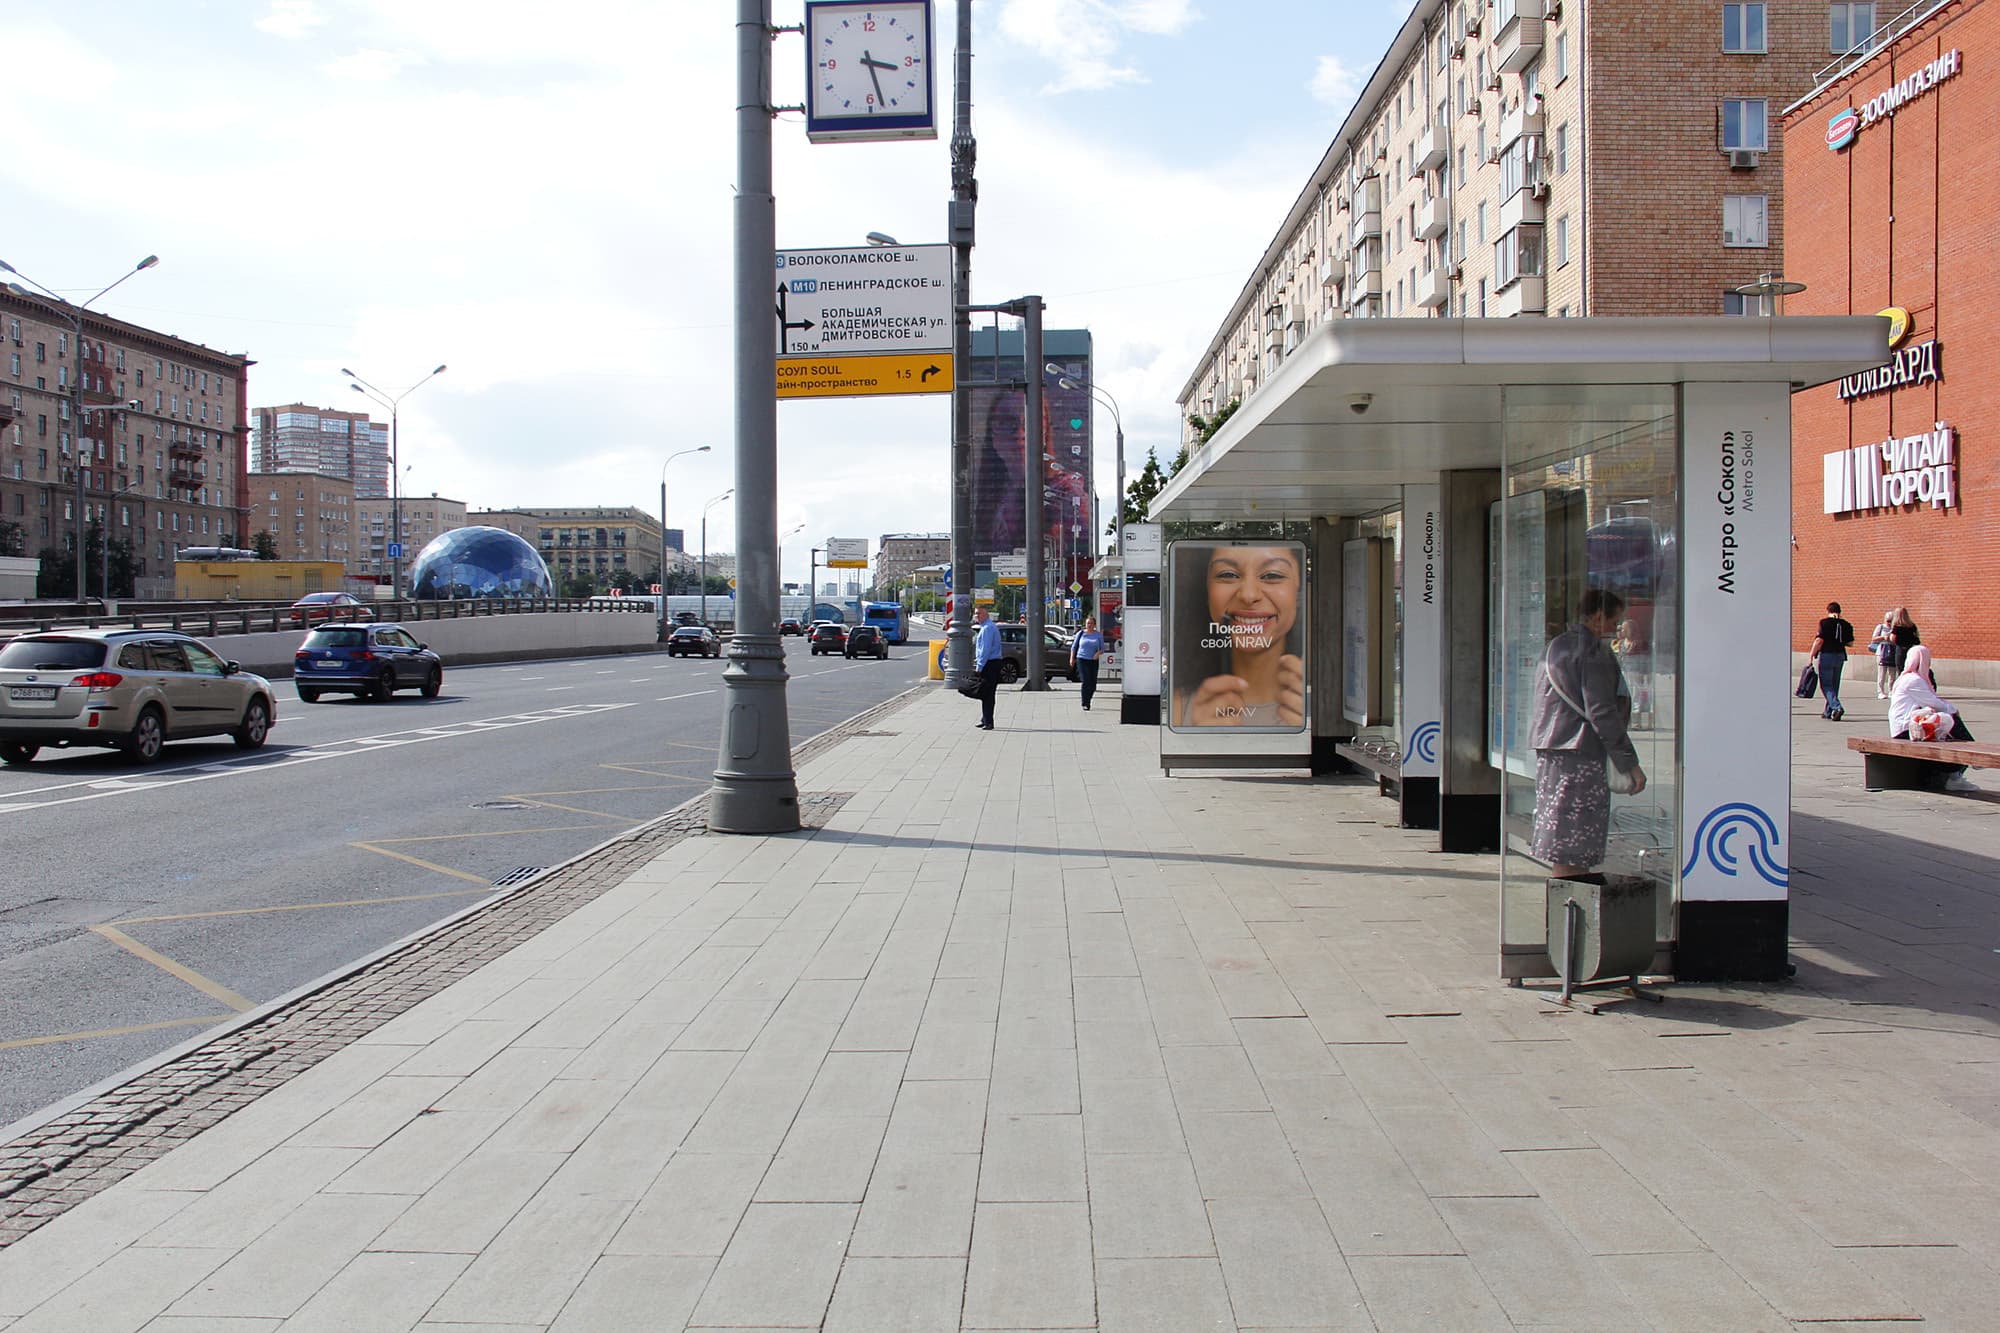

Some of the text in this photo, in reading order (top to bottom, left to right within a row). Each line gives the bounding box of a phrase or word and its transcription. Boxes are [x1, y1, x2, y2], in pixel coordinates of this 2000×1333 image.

[863, 20, 876, 32] 12
[828, 55, 913, 70] 9 3
[1860, 48, 1958, 127] ЗООМАГАЗИН
[866, 93, 875, 105] 6
[776, 252, 919, 268] 9 ВОЛОКОЛАМСКОЕ ш.
[820, 277, 928, 291] ЛЕНИНГРАДСКОЕ
[931, 279, 945, 288] ш.
[821, 306, 882, 319] БОЛЬШАЯ
[822, 316, 947, 330] АКАДЕМИЧЕСКАЯ ул.
[821, 328, 927, 342] ДМИТРОВСКОЕ ш.
[791, 342, 809, 351] 150
[811, 365, 842, 375] SOUL
[896, 369, 912, 379] 1.5
[776, 378, 878, 392] айн-пространство
[1880, 420, 1953, 473] ЧИТАЙ
[1742, 430, 1753, 512] Metro Sokol
[1882, 464, 1954, 510] ГОРОД
[1717, 431, 1738, 594] Метро «Сокол»
[1423, 511, 1435, 604] Метро «Сокол»
[1209, 622, 1264, 634] Покажи
[1200, 636, 1273, 648] свой NRAV
[1215, 706, 1257, 718] NRAV
